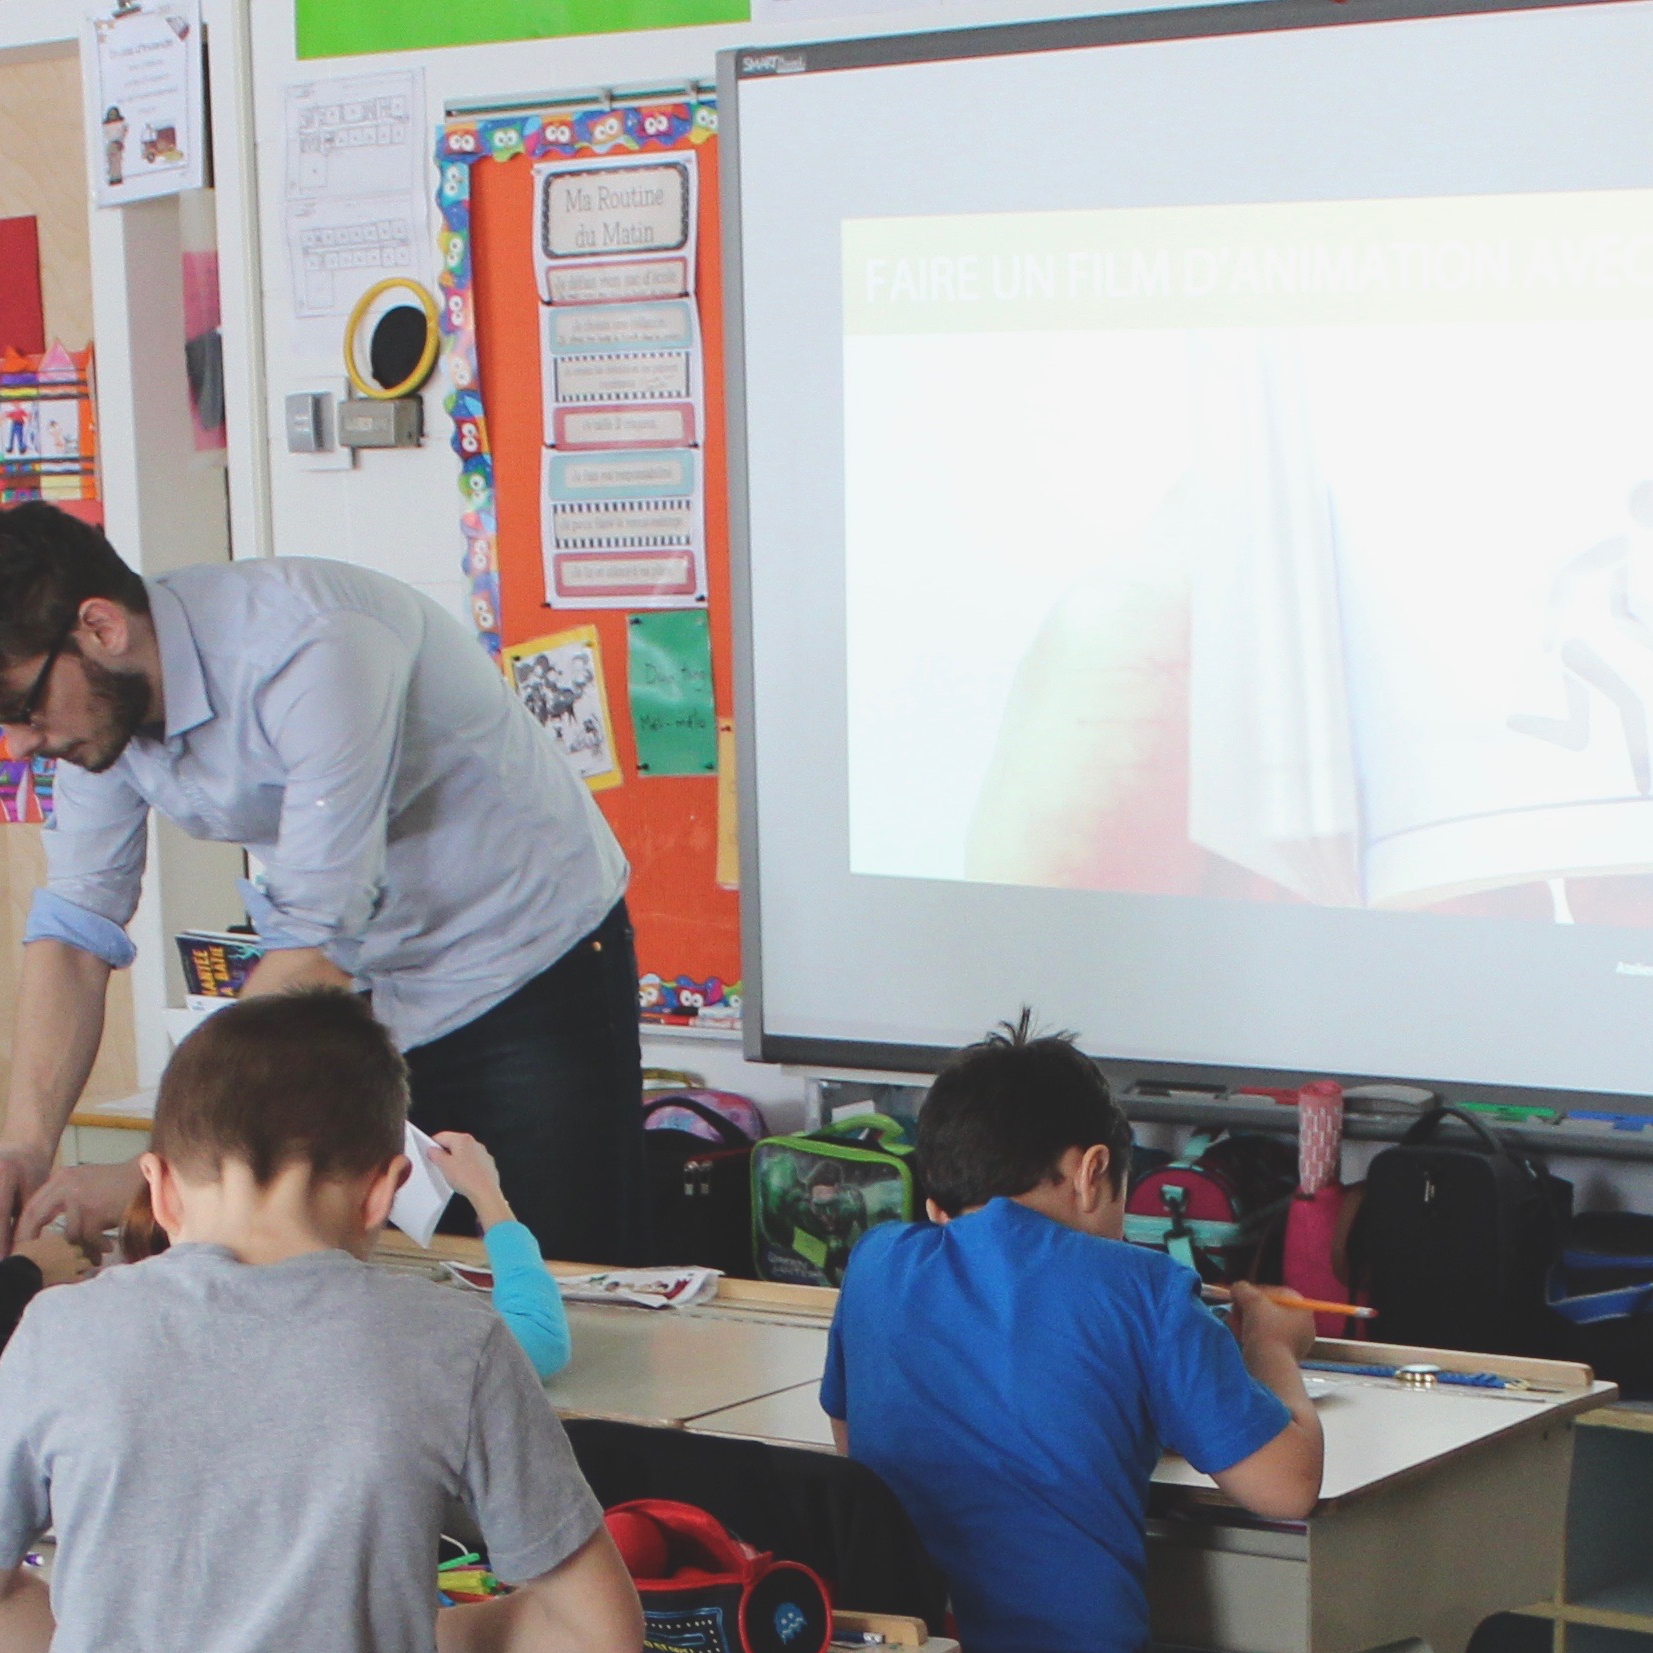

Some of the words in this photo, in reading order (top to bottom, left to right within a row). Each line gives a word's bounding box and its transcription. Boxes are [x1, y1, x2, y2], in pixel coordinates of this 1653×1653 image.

[565, 187, 592, 213] Ma
[598, 184, 664, 211] Routine
[575, 223, 596, 248] du
[603, 220, 654, 246] Matin
[865, 255, 980, 303] FAIRE
[991, 253, 1055, 301] UN
[1067, 250, 1171, 300] FILM
[1184, 242, 1509, 297] D'ANIMATION
